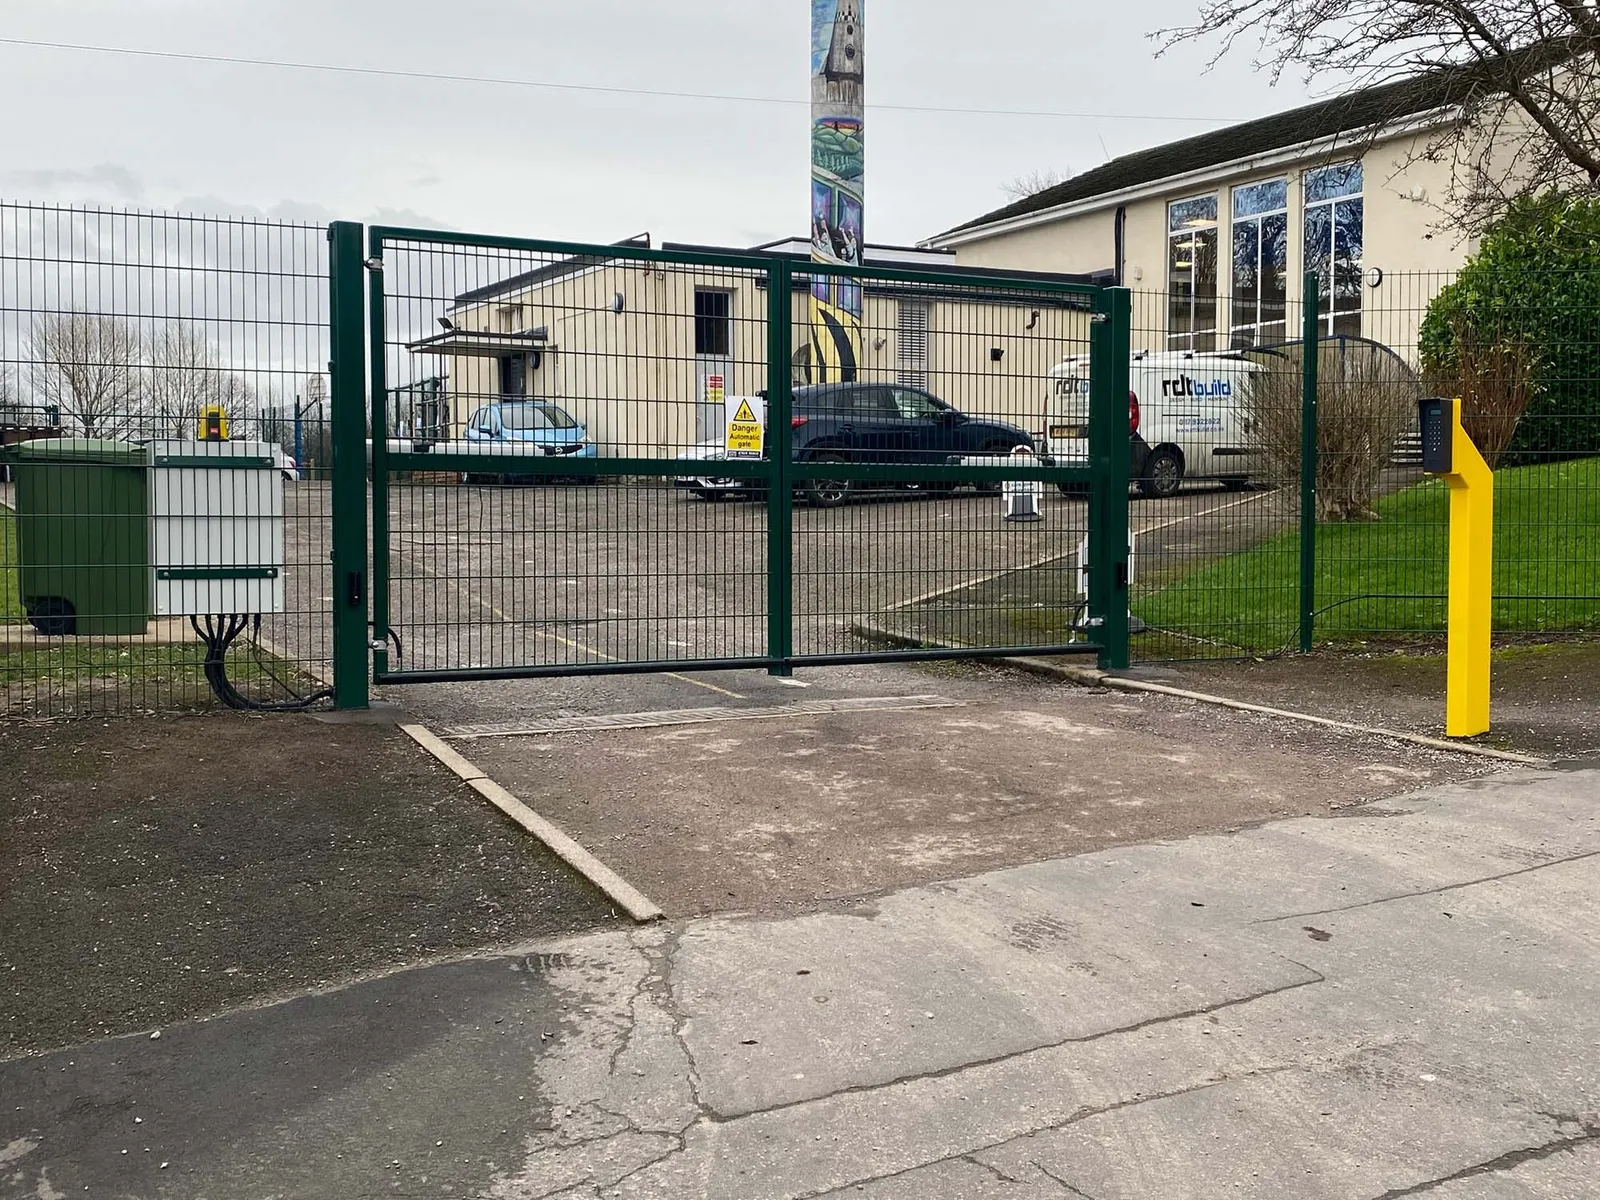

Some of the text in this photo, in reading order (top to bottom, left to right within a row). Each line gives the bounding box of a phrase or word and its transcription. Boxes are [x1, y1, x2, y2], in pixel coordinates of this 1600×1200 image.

[1056, 374, 1088, 395] rdtb
[1162, 374, 1231, 396] rdtbuild
[731, 424, 758, 434] Danger
